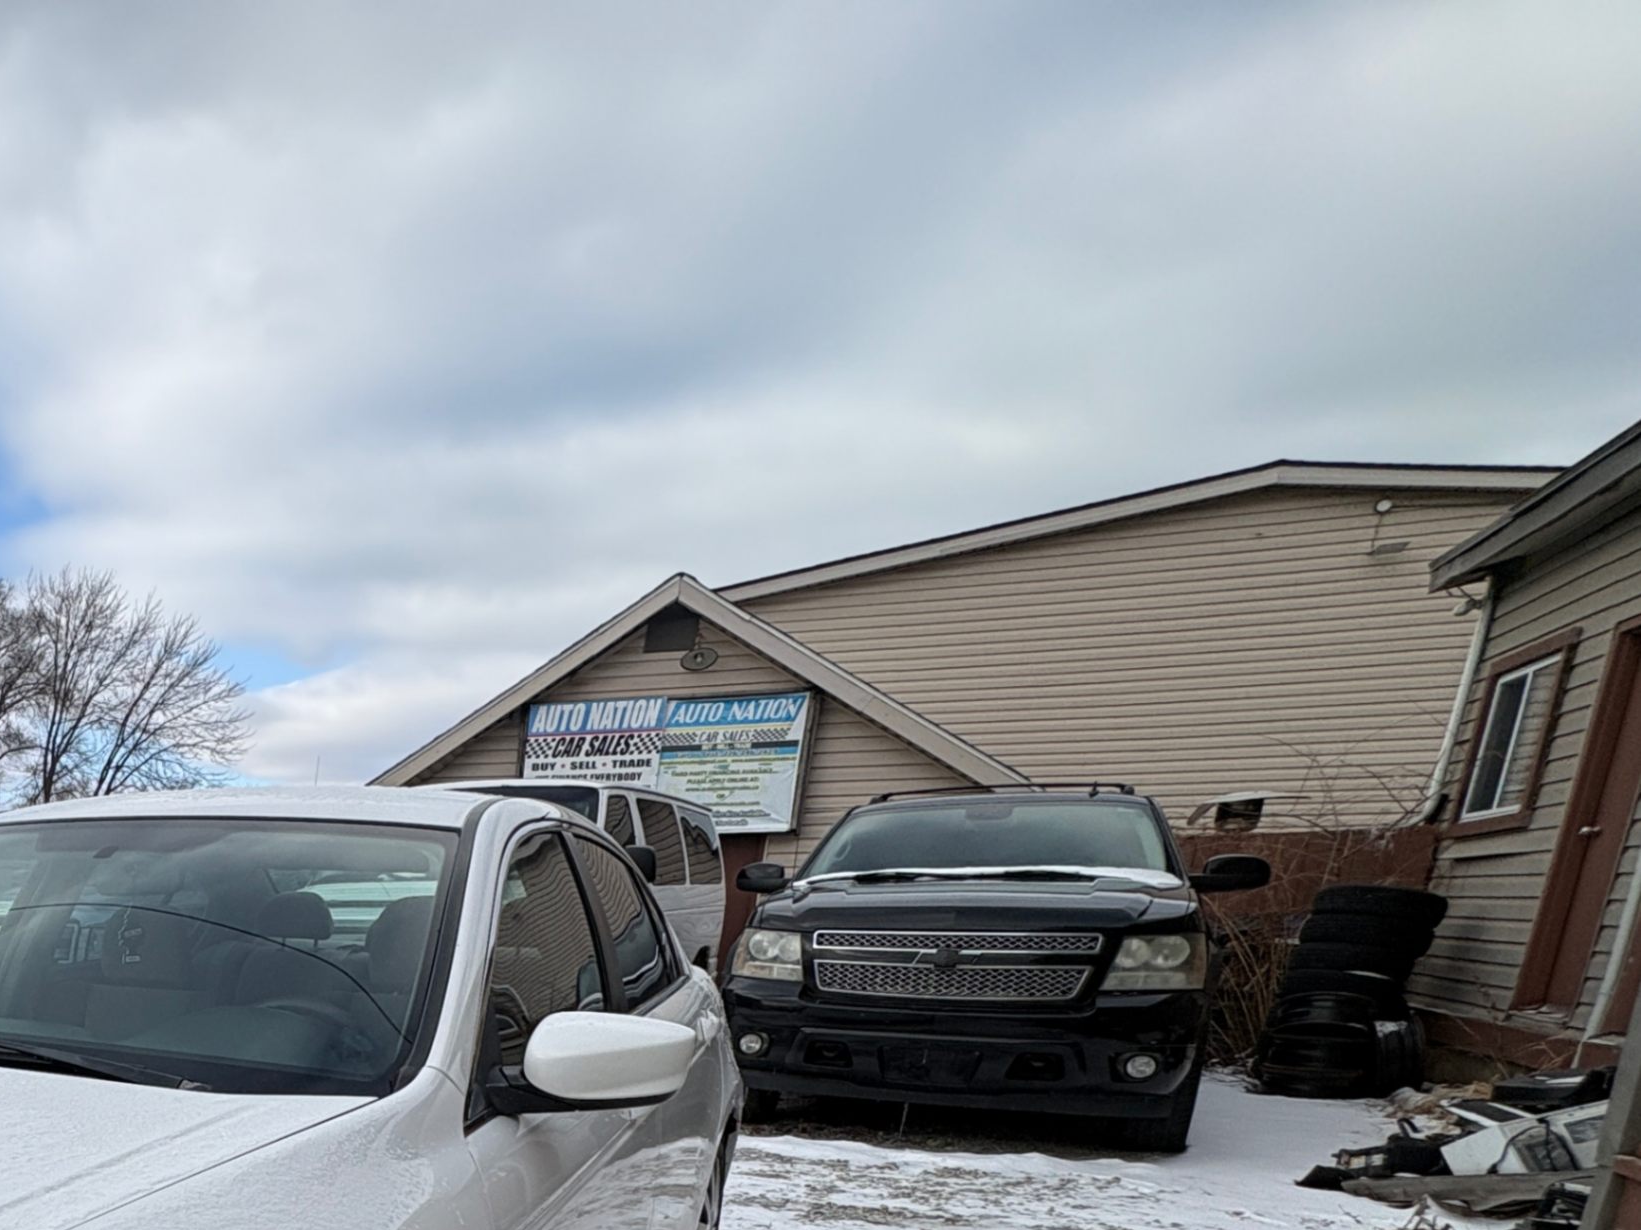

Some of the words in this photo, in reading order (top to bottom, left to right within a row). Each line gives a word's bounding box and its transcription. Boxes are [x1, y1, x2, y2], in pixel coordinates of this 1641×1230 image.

[532, 703, 586, 733] AUTO
[586, 698, 663, 730] NATION
[671, 702, 724, 723] AUTO
[727, 697, 802, 721] NATION
[698, 731, 719, 742] CAR
[721, 730, 752, 742] SALES
[551, 736, 586, 758] CAR
[585, 734, 635, 757] SALES
[531, 762, 557, 771] BUY
[570, 760, 597, 770] SELL
[610, 758, 652, 768] TRADE
[590, 772, 643, 782] EVERYBODY
